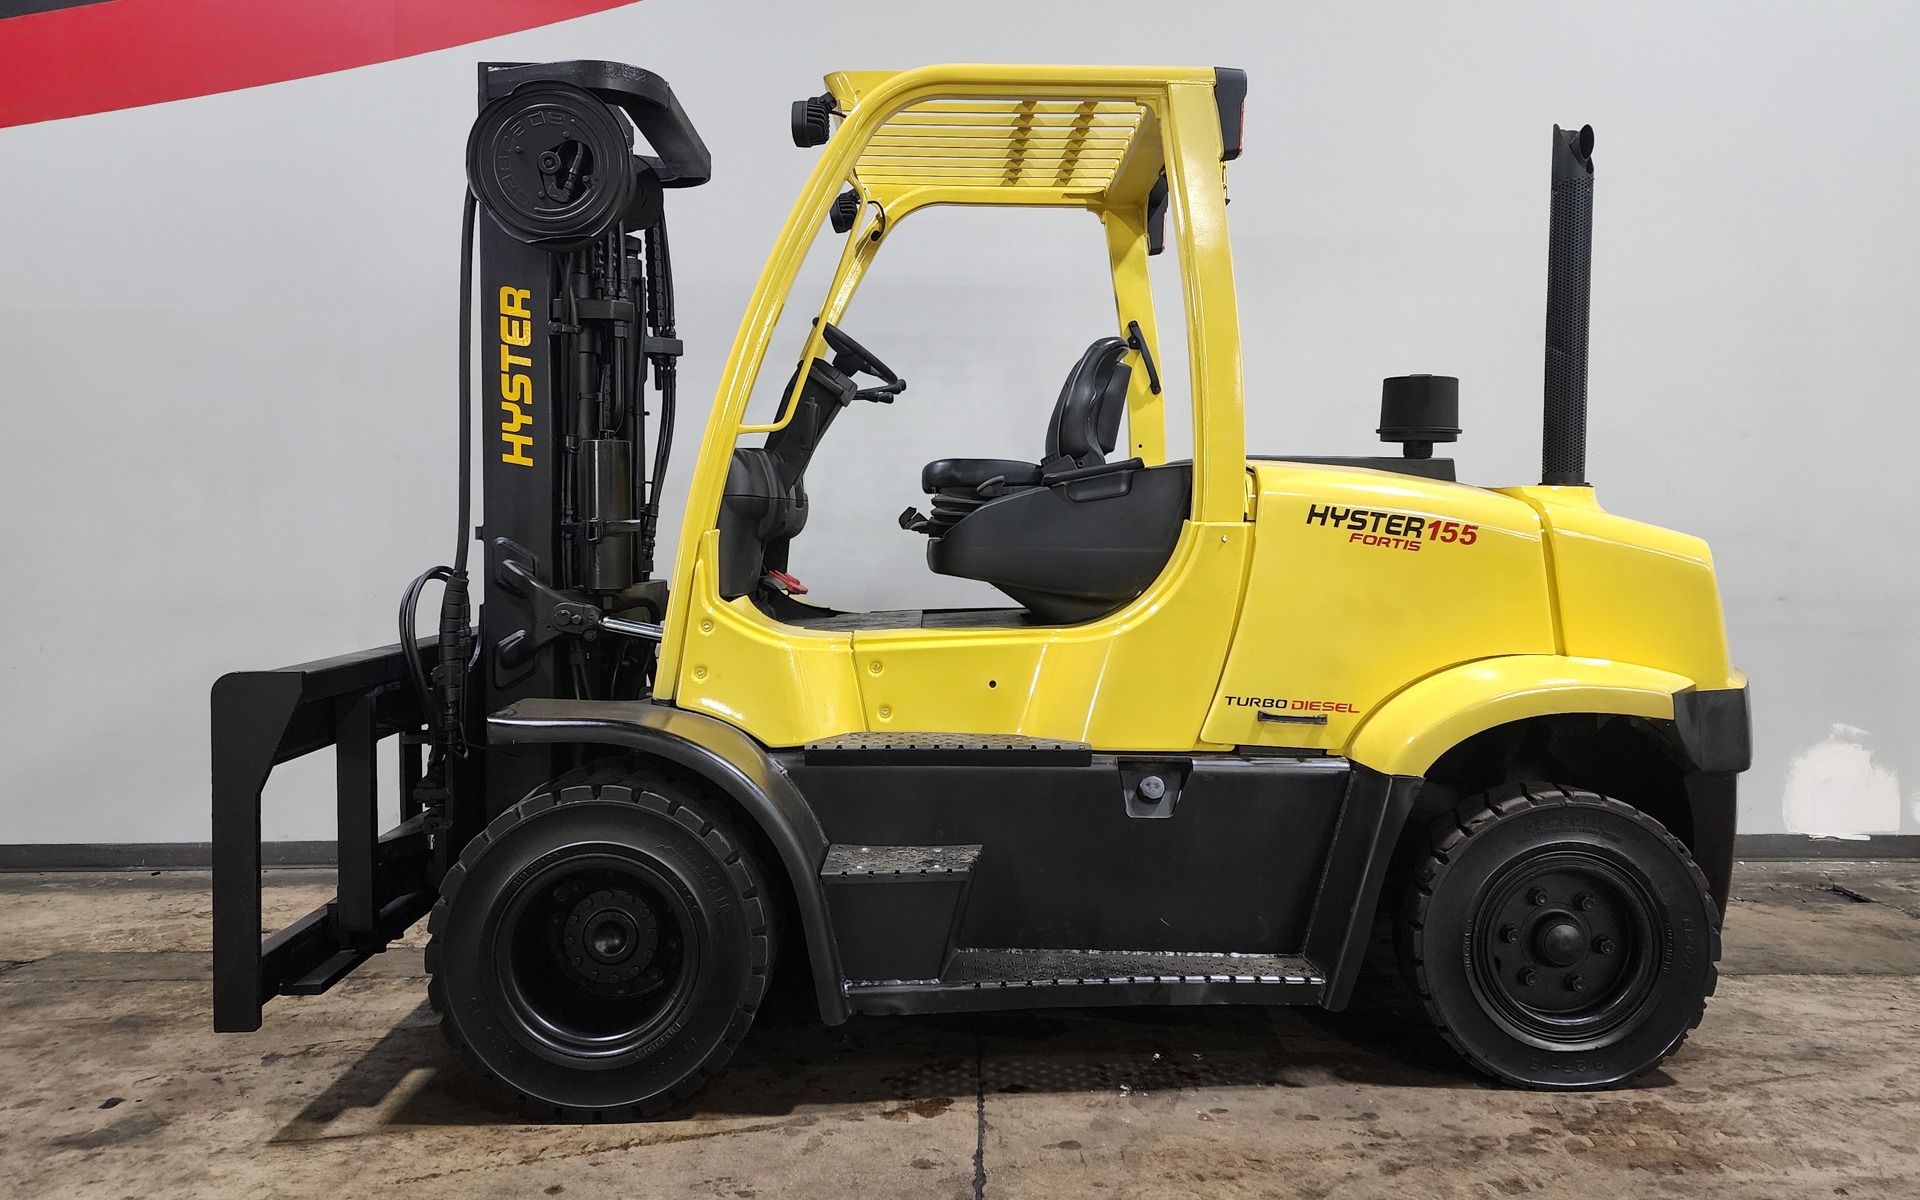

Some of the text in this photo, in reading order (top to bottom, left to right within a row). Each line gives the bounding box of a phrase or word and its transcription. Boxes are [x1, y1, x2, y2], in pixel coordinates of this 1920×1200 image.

[499, 285, 534, 467] HYSTER
[1306, 503, 1479, 546] HYSTER 155
[1349, 533, 1422, 552] FORTIS
[1224, 695, 1361, 713] TURBO DIESEL
